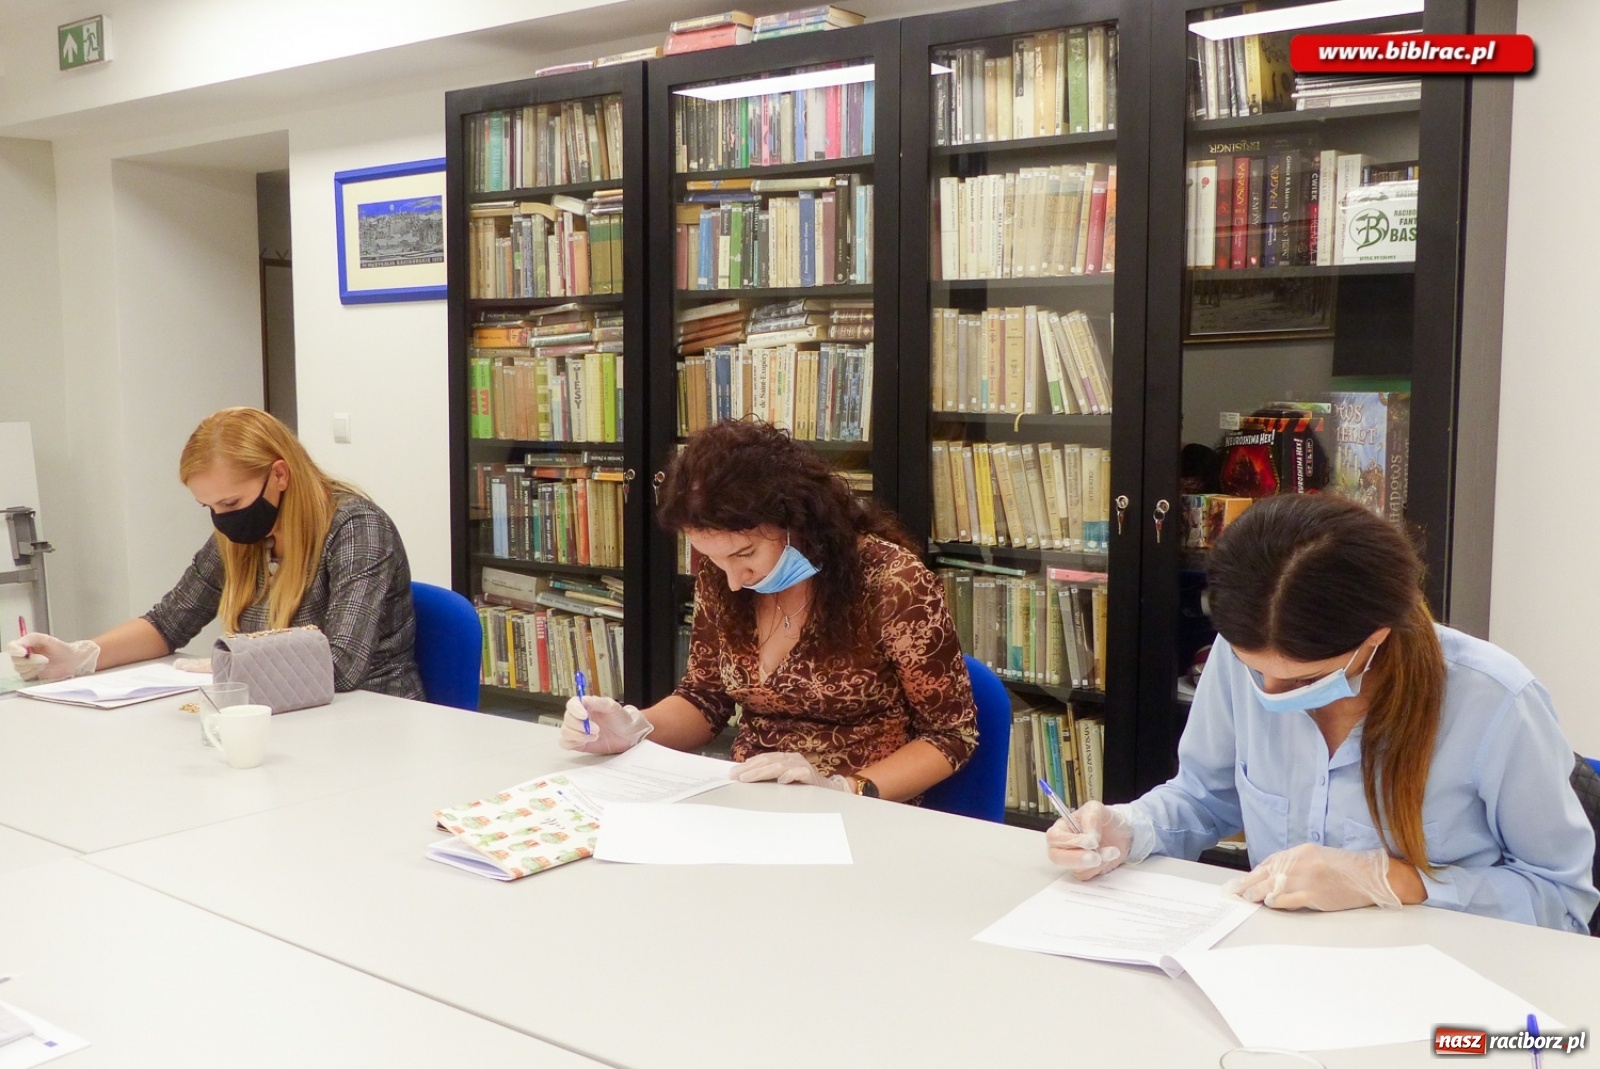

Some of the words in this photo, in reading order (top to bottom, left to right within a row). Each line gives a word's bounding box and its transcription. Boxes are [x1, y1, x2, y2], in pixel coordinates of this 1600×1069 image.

[1209, 140, 1260, 153] BRISINGR
[1390, 227, 1417, 242] BAS
[759, 352, 769, 398] Saint-Exupéry
[760, 400, 766, 408] de
[1260, 429, 1275, 446] HEX!
[1389, 454, 1402, 523] HADOWS
[536, 616, 545, 639] HELLER
